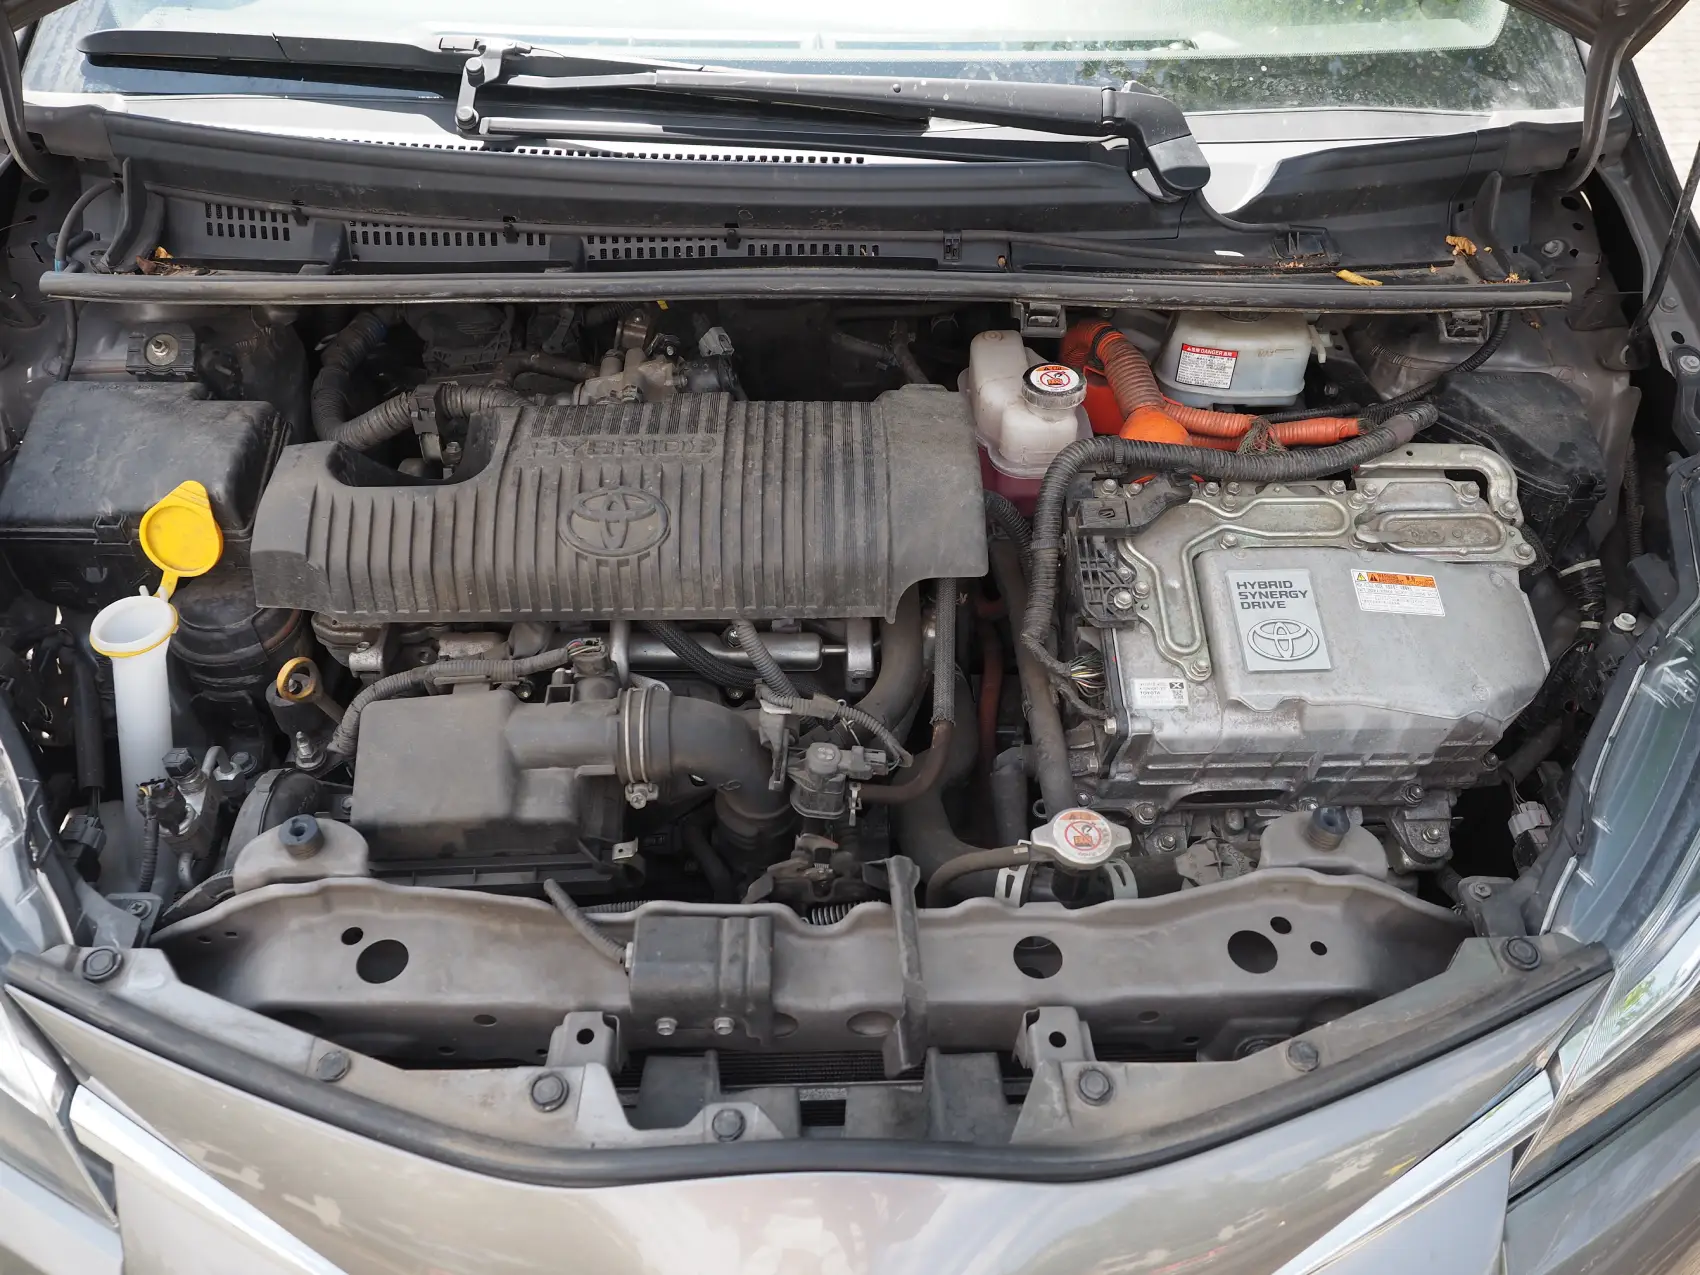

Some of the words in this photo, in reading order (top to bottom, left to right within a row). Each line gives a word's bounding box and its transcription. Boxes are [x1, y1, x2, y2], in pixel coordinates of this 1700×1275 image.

[1236, 580, 1293, 590] HYBRID
[1238, 590, 1308, 600] SYNERGY
[1240, 600, 1287, 610] DRIVE
